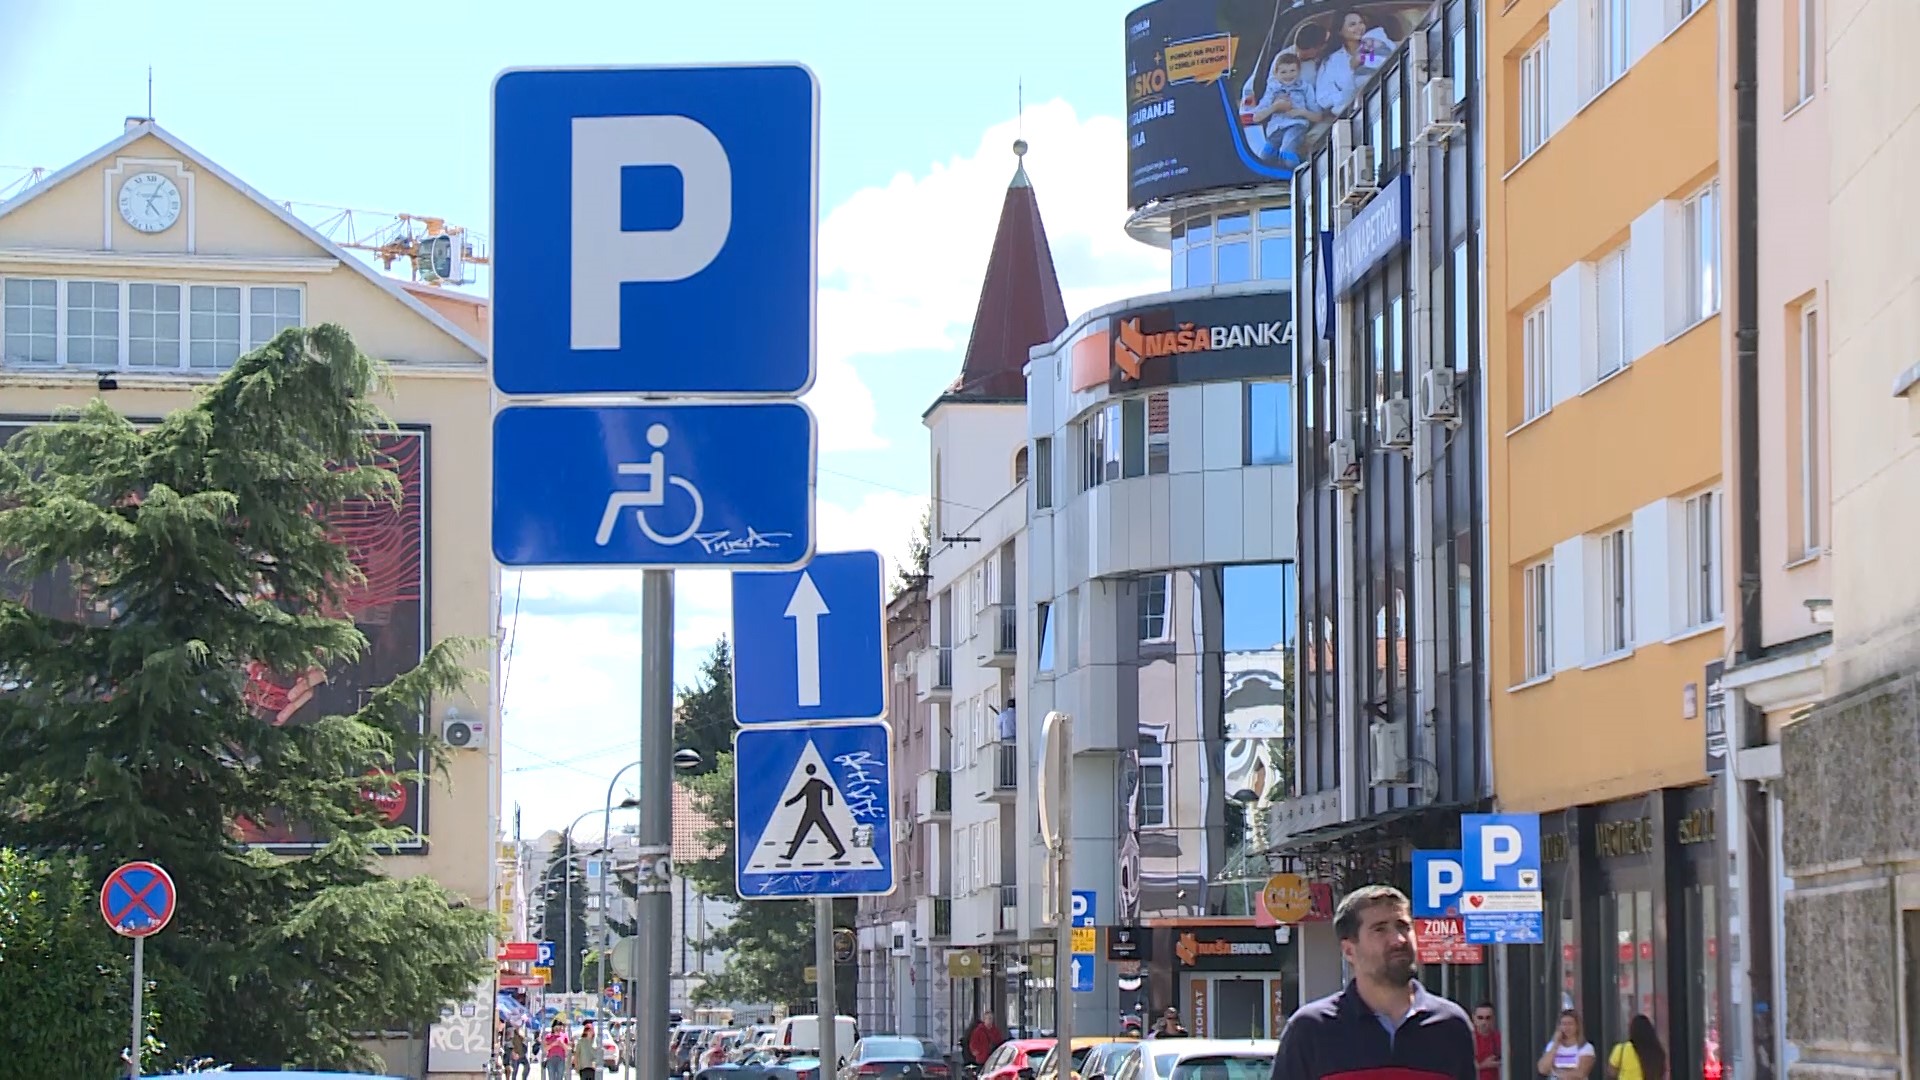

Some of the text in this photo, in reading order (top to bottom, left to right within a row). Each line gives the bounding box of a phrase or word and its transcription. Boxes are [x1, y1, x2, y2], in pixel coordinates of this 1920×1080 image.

[570, 114, 732, 351] P
[1145, 320, 1293, 359] NAŠA BANKA
[1481, 825, 1522, 881] P
[1428, 859, 1463, 908] P
[1072, 895, 1087, 924] P
[1424, 919, 1459, 935] ZONA
[539, 946, 551, 964] P
[1231, 942, 1273, 955] BANKA
